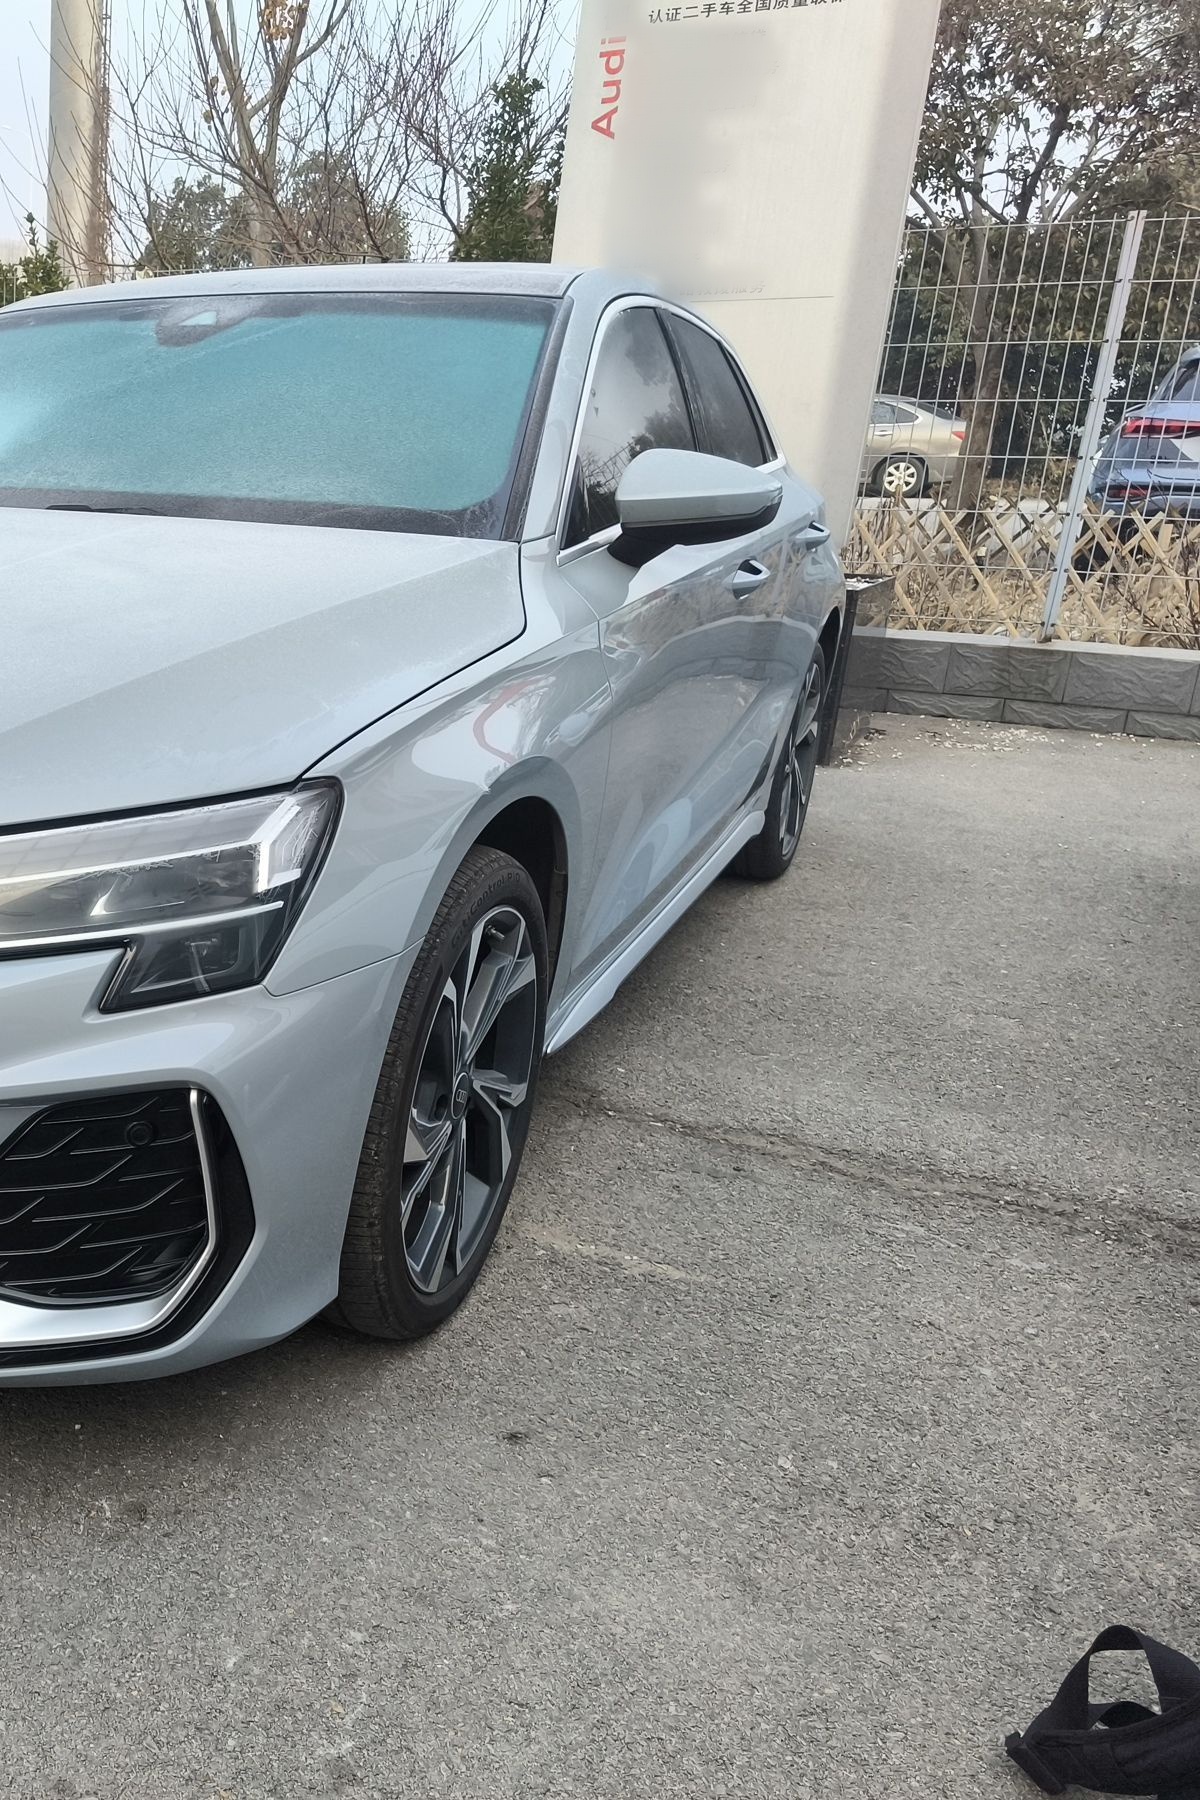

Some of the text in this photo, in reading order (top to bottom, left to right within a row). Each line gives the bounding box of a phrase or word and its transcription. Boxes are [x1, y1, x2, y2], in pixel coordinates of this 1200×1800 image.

[648, 0, 843, 24] 认证二手车全国质量
[591, 36, 627, 140] Audi
